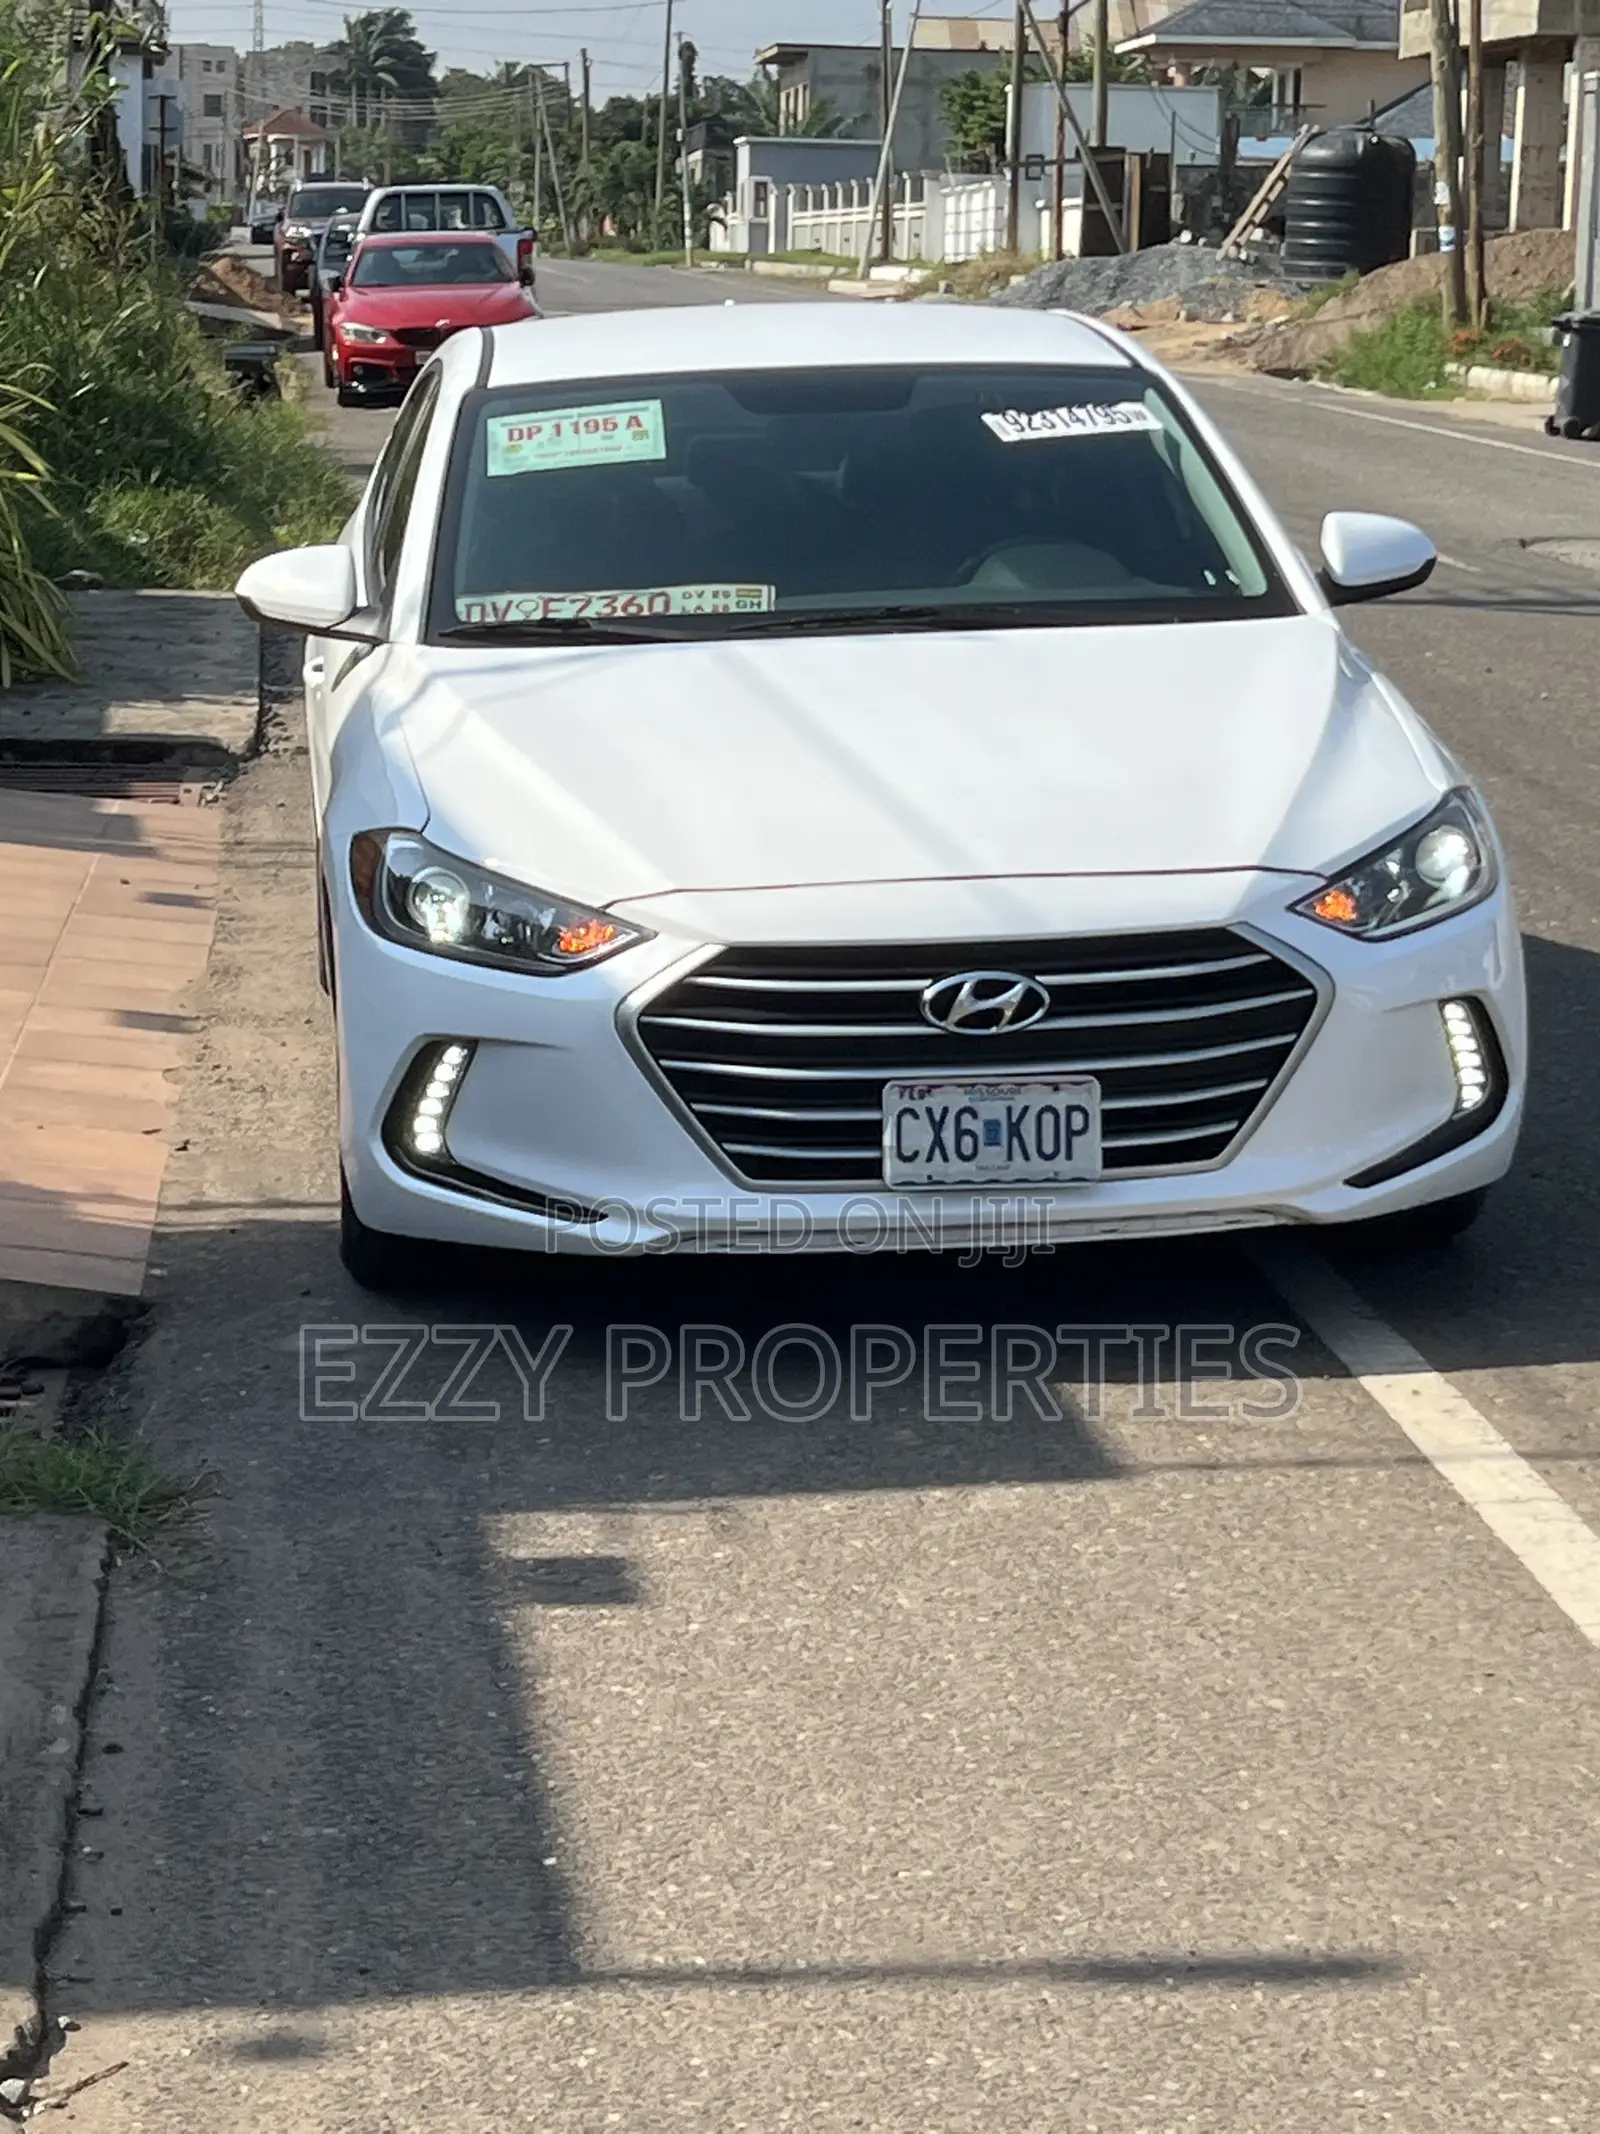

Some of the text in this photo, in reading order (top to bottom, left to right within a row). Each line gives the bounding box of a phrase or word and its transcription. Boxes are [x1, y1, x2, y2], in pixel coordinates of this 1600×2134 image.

[507, 425, 542, 442] DP
[625, 414, 644, 431] A
[896, 1105, 979, 1163] CX6
